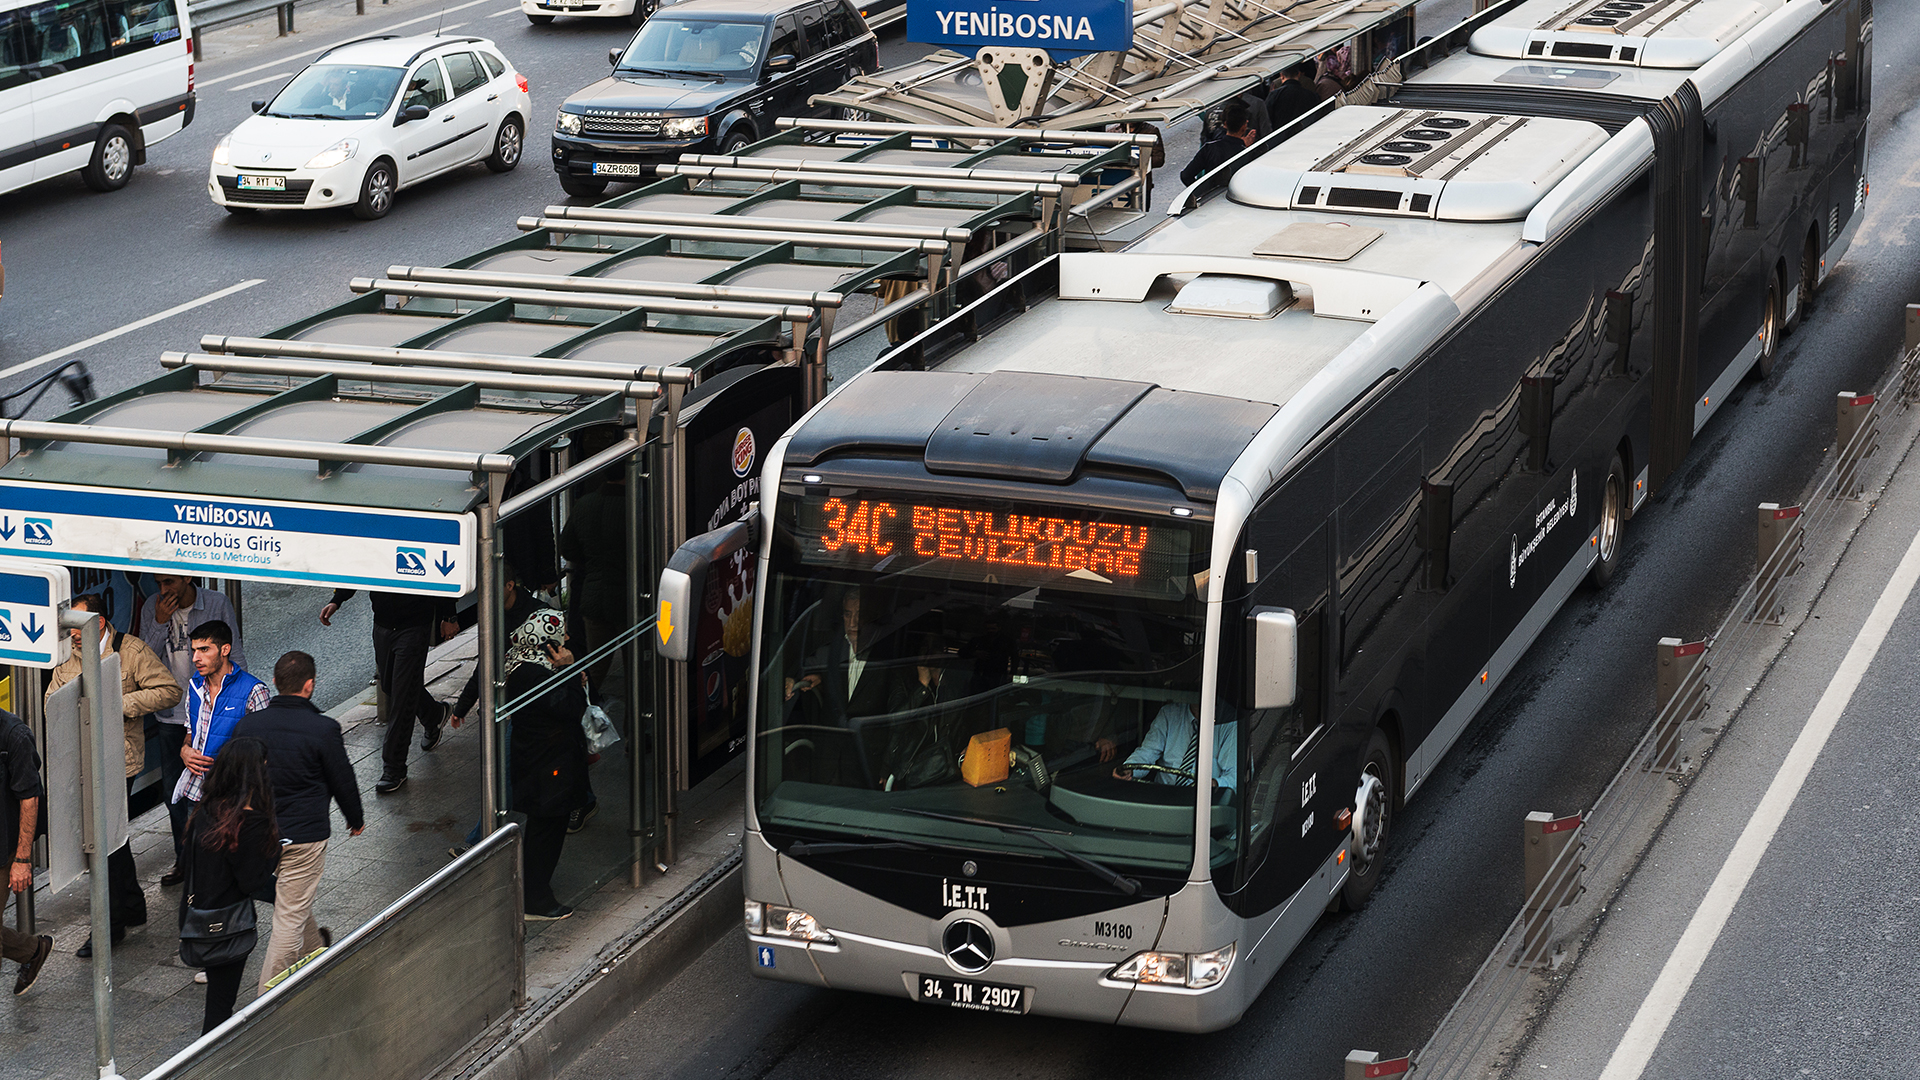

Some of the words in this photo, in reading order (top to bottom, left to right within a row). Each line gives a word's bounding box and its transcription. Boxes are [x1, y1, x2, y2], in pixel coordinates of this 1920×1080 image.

[936, 6, 1095, 41] YENİBOSNA
[242, 176, 251, 186] 34
[256, 177, 270, 187] RYT
[274, 178, 284, 188] 42
[734, 441, 753, 470] KING
[730, 480, 749, 509] BOY
[173, 503, 274, 528] YENİBOSNA
[820, 497, 897, 556] 34C
[912, 505, 1149, 550] BEYLIKDUZU
[165, 529, 241, 550] Metrobüs
[247, 535, 282, 557] Giriş
[175, 548, 208, 560] Access
[211, 551, 221, 561] to
[223, 552, 272, 565] Metrobus
[943, 877, 990, 911] İ.E.T.T.
[1094, 921, 1133, 940] M3180
[924, 978, 944, 999] 34
[953, 982, 973, 1003] TN
[981, 986, 1021, 1009] 2907
